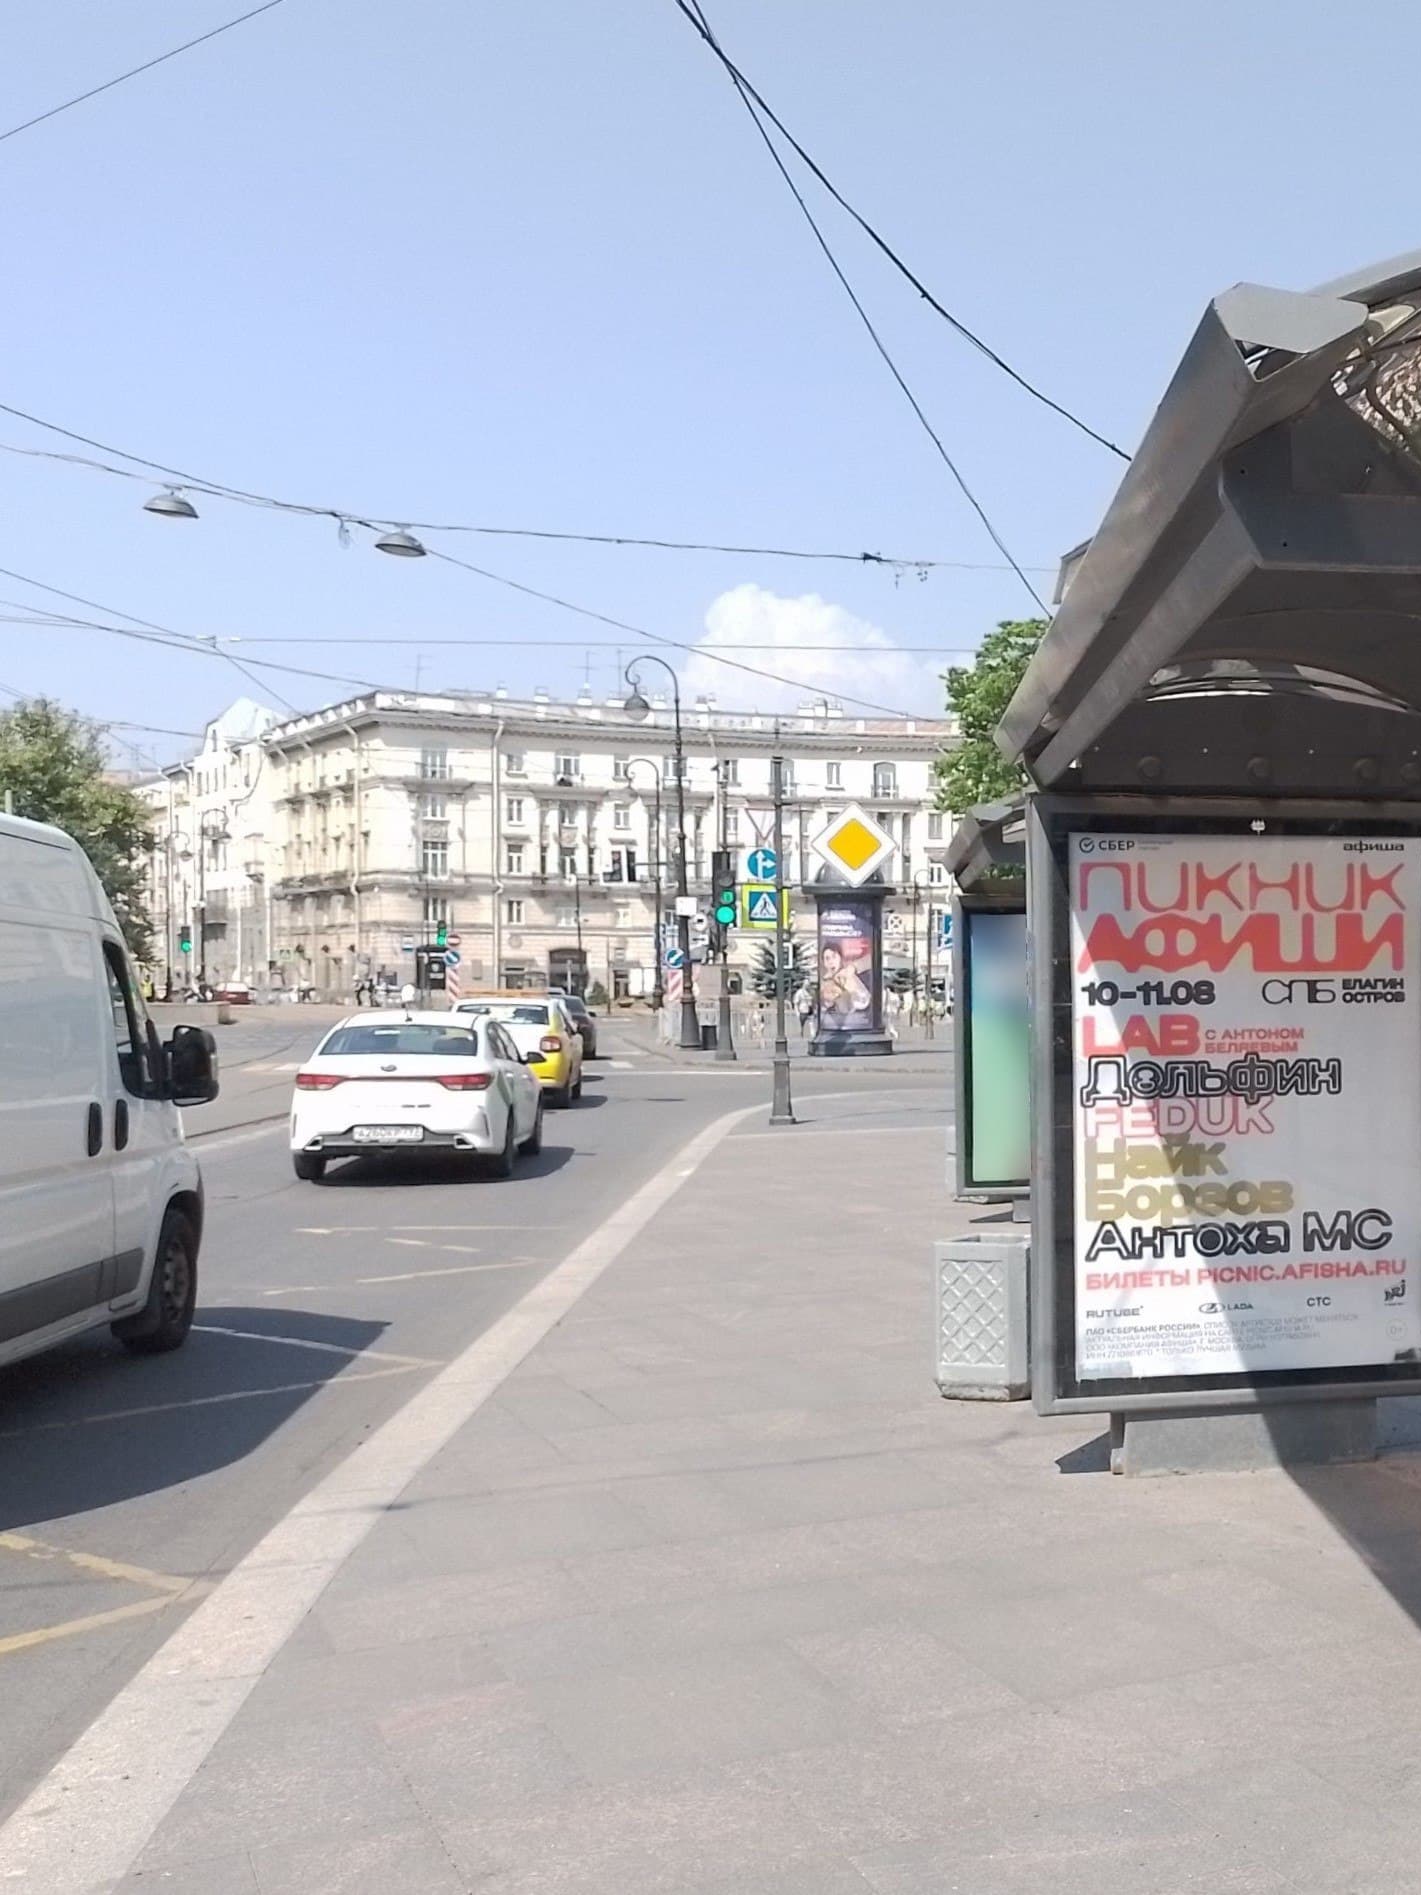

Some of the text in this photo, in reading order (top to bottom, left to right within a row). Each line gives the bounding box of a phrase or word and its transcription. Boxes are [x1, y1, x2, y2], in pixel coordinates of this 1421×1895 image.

[1098, 839, 1136, 851] СБЕР
[1342, 840, 1405, 853] афиша
[1079, 861, 1406, 913] ПИКНИК
[1077, 912, 1405, 973] АФИШИ
[1342, 977, 1405, 991] ЕЛАГИН
[1262, 978, 1337, 1005] СПБ
[1342, 990, 1406, 1004] ОСТРОВ
[1081, 1013, 1201, 1057] LAB
[1221, 1027, 1305, 1041] АНТОНОМ
[1204, 1040, 1299, 1054] БЕЛЯЕВЫМ
[1086, 1259, 1407, 1291] БИЛЕТЫ PICNIC.AFISHA.RU
[1227, 1302, 1254, 1311] LADA
